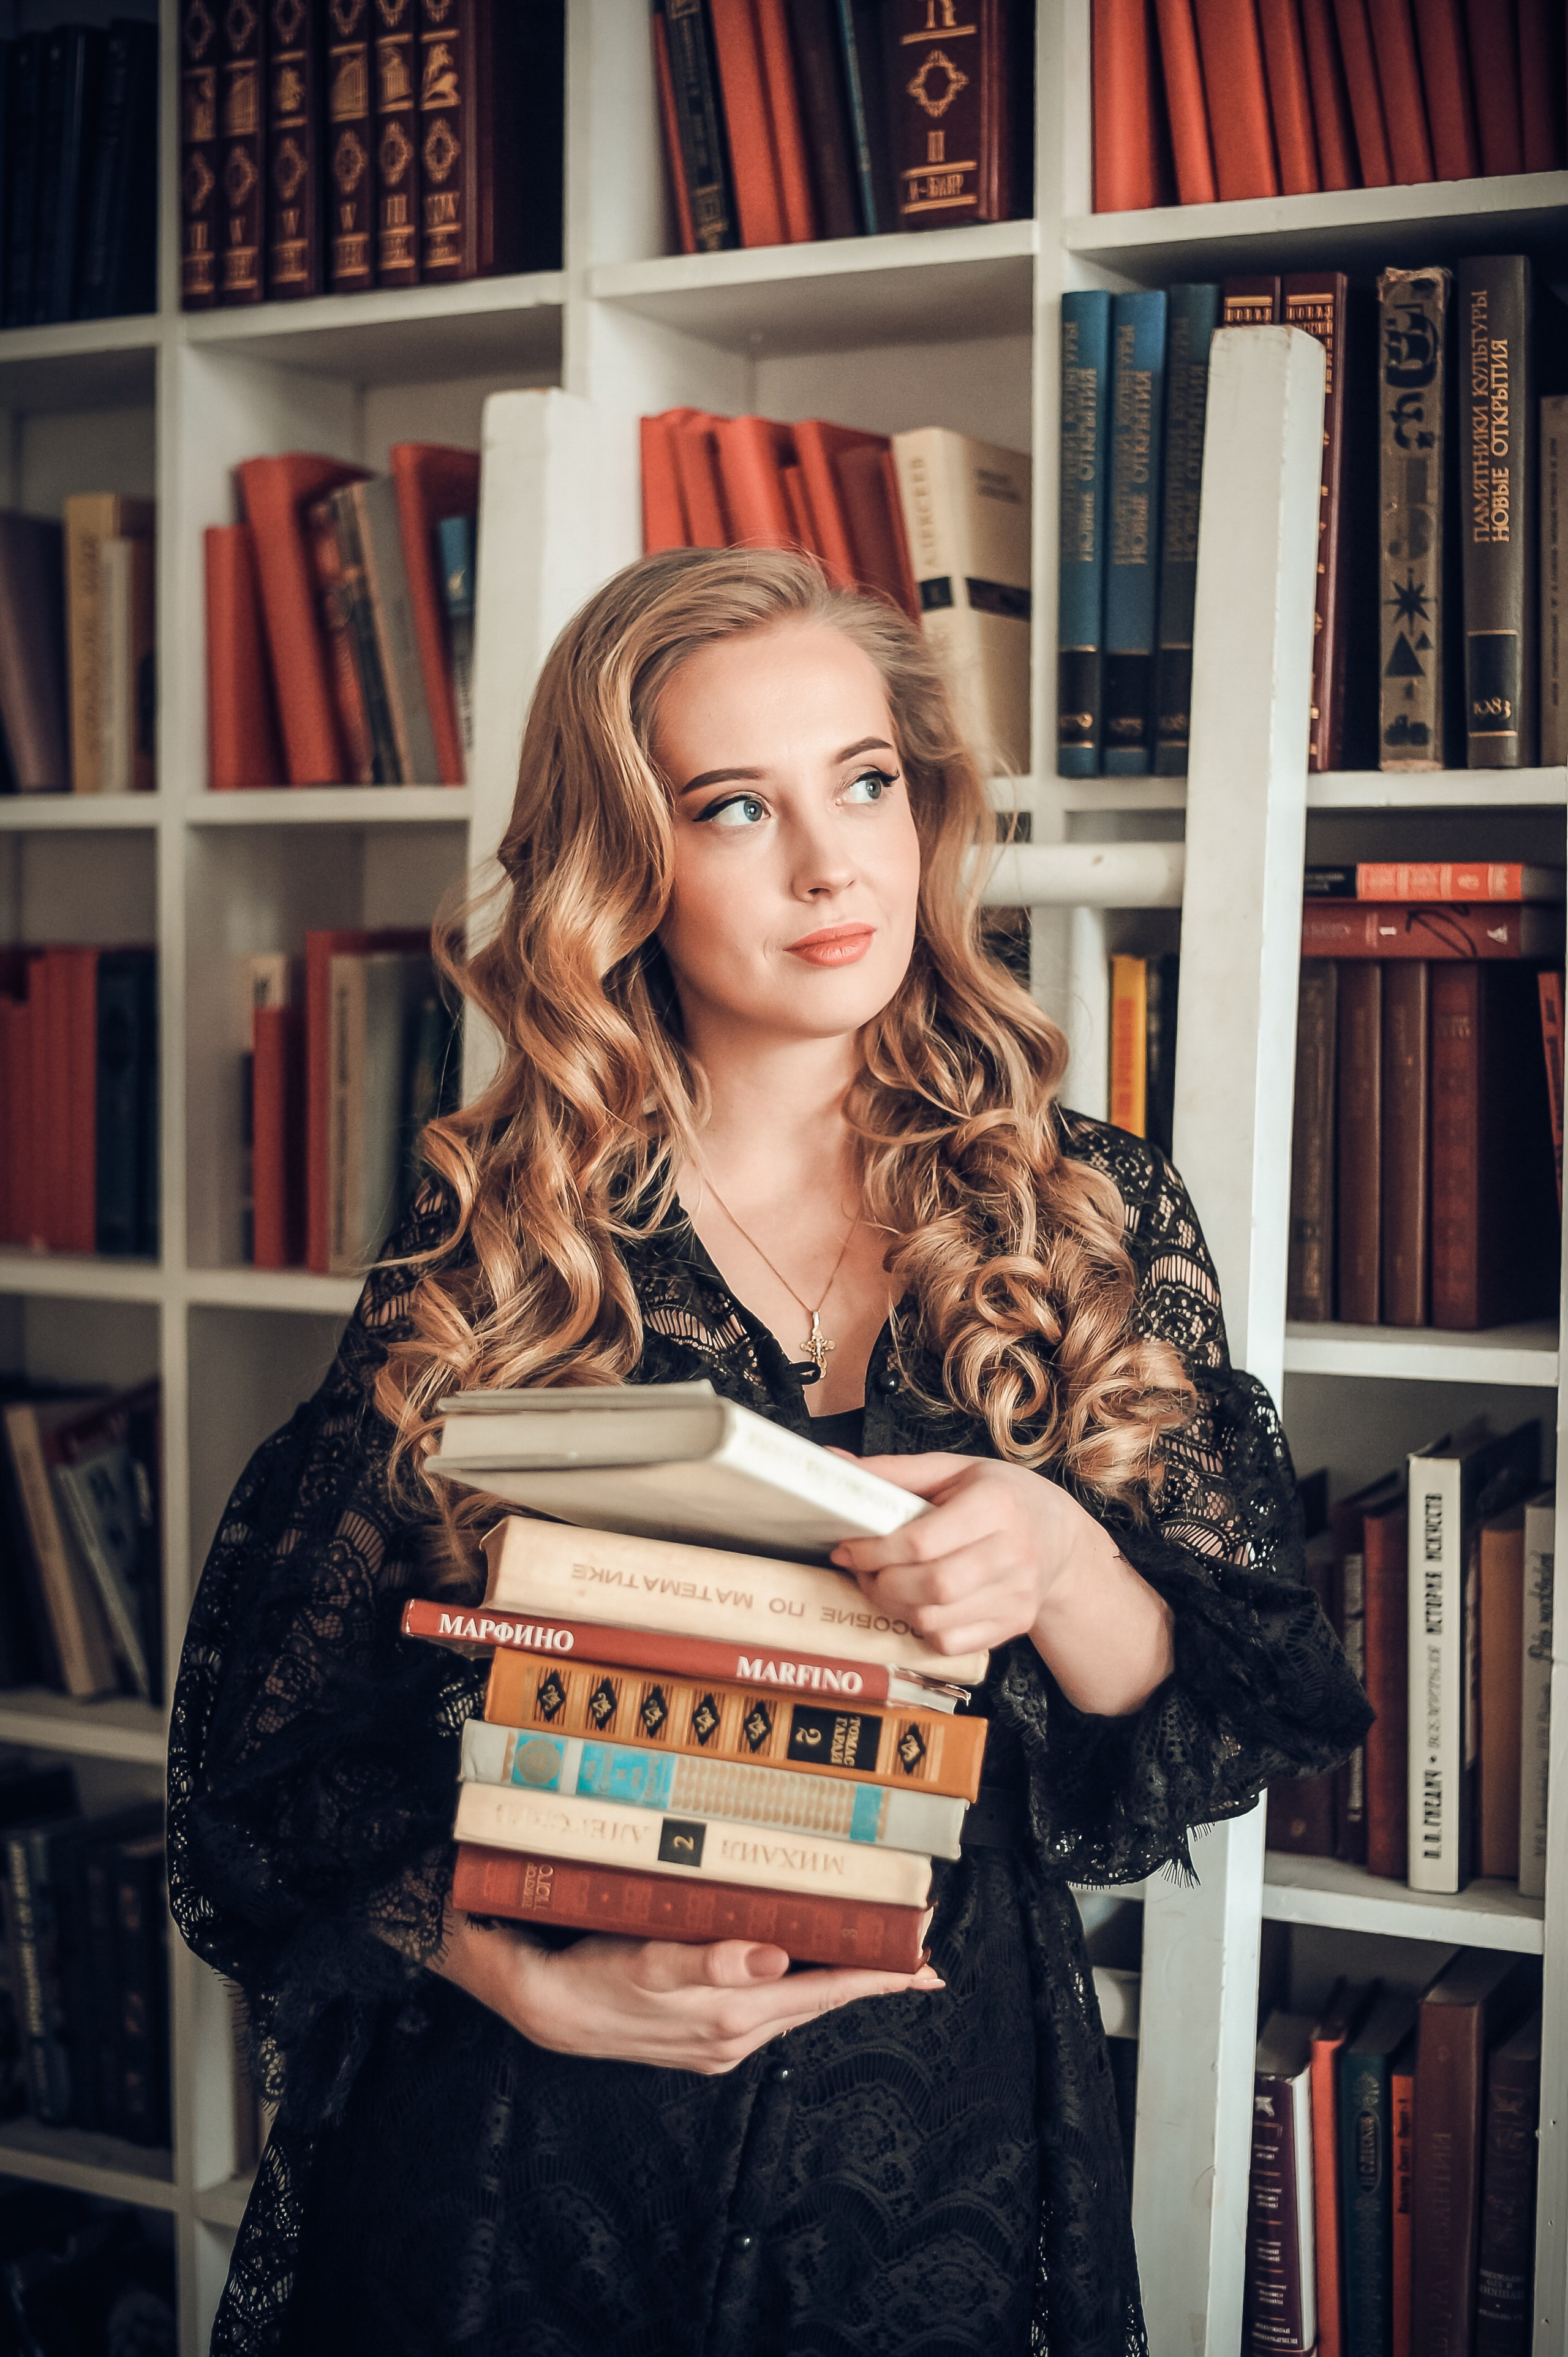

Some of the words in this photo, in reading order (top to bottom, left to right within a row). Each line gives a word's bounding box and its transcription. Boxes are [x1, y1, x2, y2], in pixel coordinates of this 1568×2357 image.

[1287, 306, 1333, 320] НОВАЯ
[1471, 290, 1488, 396] КУЛЬТУРЫ
[1490, 339, 1509, 457] ОТКРЫТИЯ
[1079, 368, 1096, 481] ОТКРЫТИЯ
[1133, 371, 1152, 483] ОТКРЫТИЯ
[1471, 405, 1490, 543] ПАМЯТНИКИ
[1491, 467, 1509, 542] НОВЫЕ
[571, 1562, 753, 1610] МАТЕМАТИКЕ
[769, 1597, 805, 1618] ПО
[1424, 1571, 1442, 1635] ИСТОРИЯ
[439, 1611, 575, 1652] МАРФИНО
[736, 1656, 864, 1695] MARFINO
[794, 1727, 822, 1747] 2
[844, 1717, 861, 1768] ТОМАС
[673, 1834, 695, 1851] 2
[720, 1841, 845, 1876] МИХАИЛ
[533, 1864, 553, 1911] ГЮГО
